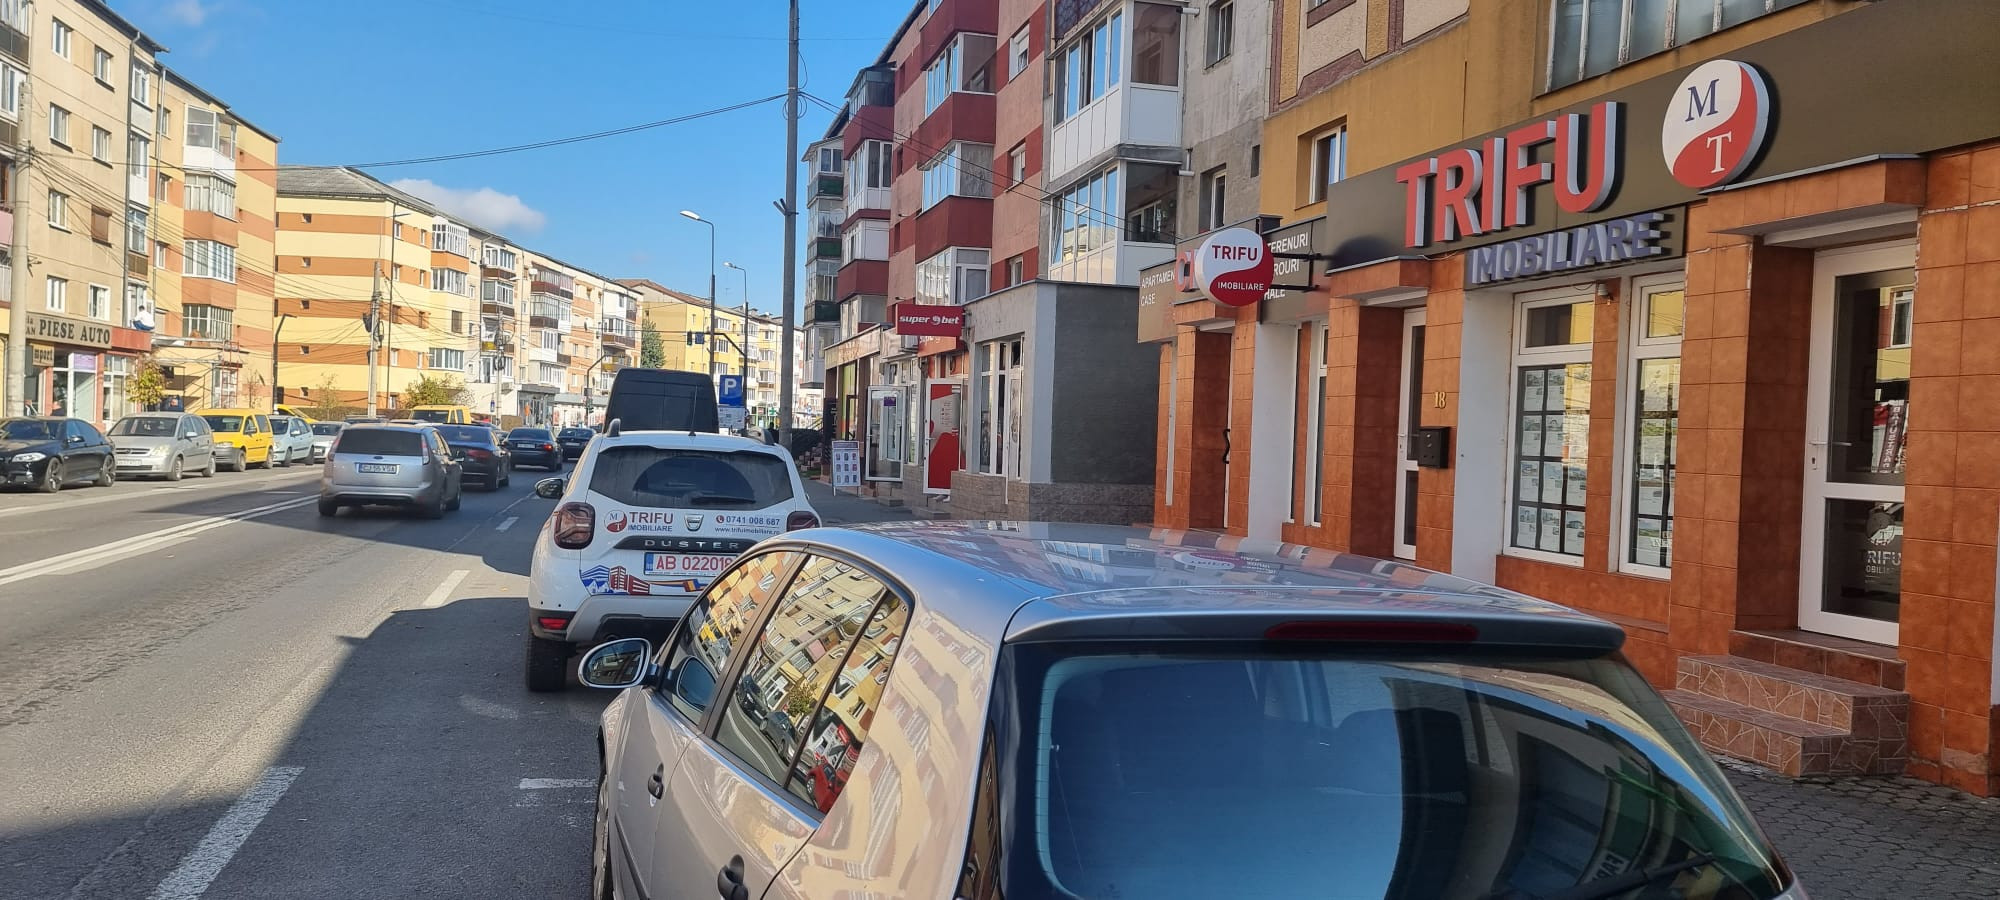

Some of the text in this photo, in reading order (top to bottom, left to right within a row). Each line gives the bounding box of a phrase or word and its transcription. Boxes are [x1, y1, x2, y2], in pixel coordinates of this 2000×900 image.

[1685, 79, 1719, 122] M
[1706, 131, 1732, 174] T
[1396, 101, 1618, 248] TRIFU
[1211, 245, 1258, 261] TRIFU
[1467, 212, 1664, 285] IMOBILIARE
[1217, 281, 1264, 291] IMOBILIARE
[1140, 293, 1156, 306] CASE
[39, 319, 110, 344] PIESE AUTO
[724, 378, 737, 396] P
[1433, 391, 1447, 408] 18
[629, 512, 674, 525] TRIFU
[726, 516, 746, 524] 0741
[766, 518, 780, 526] 687
[645, 541, 740, 549] DUSTER
[656, 555, 677, 570] AB
